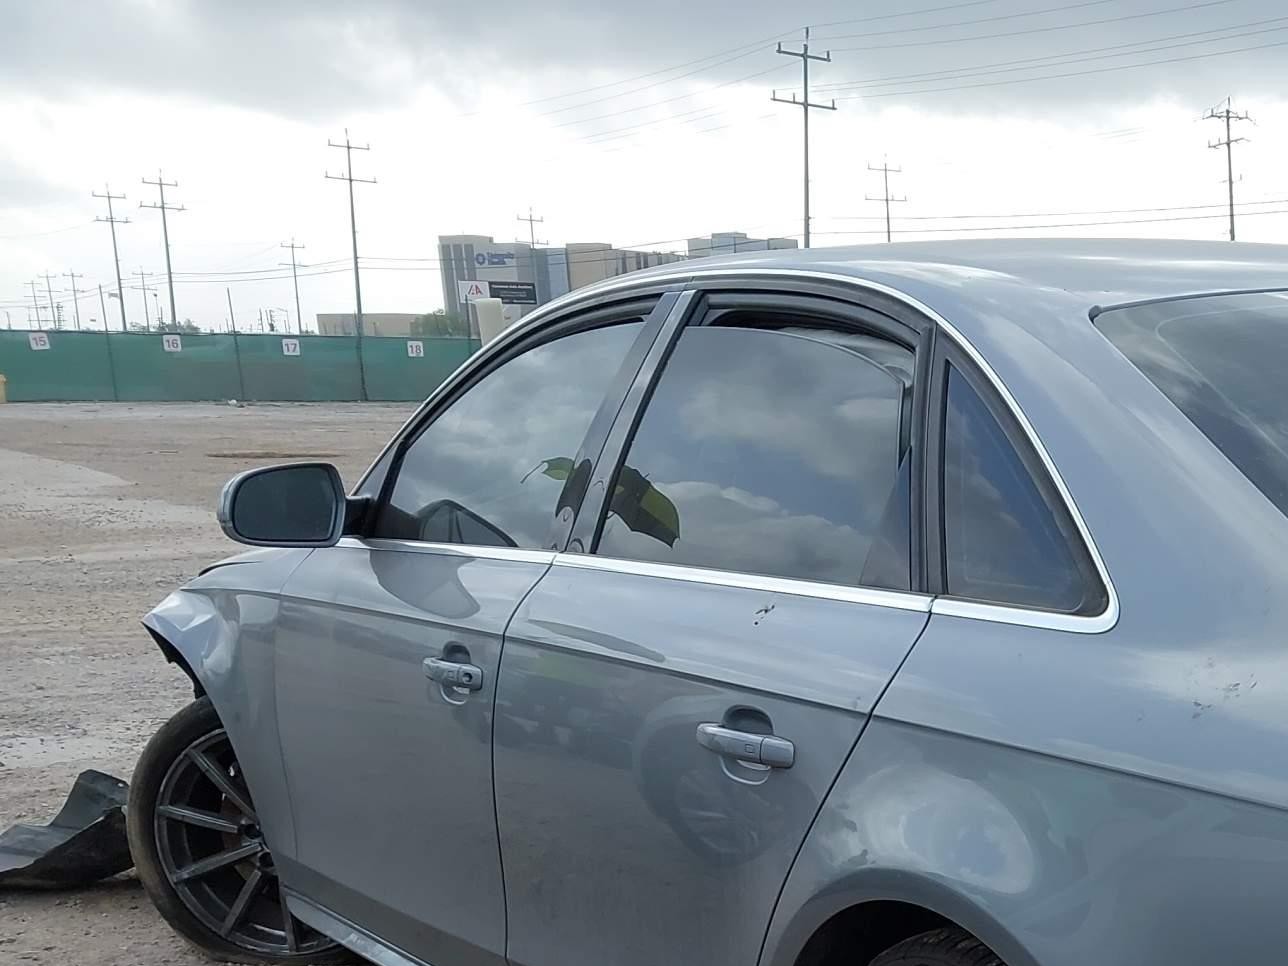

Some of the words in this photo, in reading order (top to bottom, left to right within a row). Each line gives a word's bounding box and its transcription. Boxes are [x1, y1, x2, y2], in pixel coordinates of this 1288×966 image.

[31, 336, 47, 347] 15
[165, 338, 179, 349] 16
[285, 343, 297, 352] 17
[409, 344, 422, 354] 18
